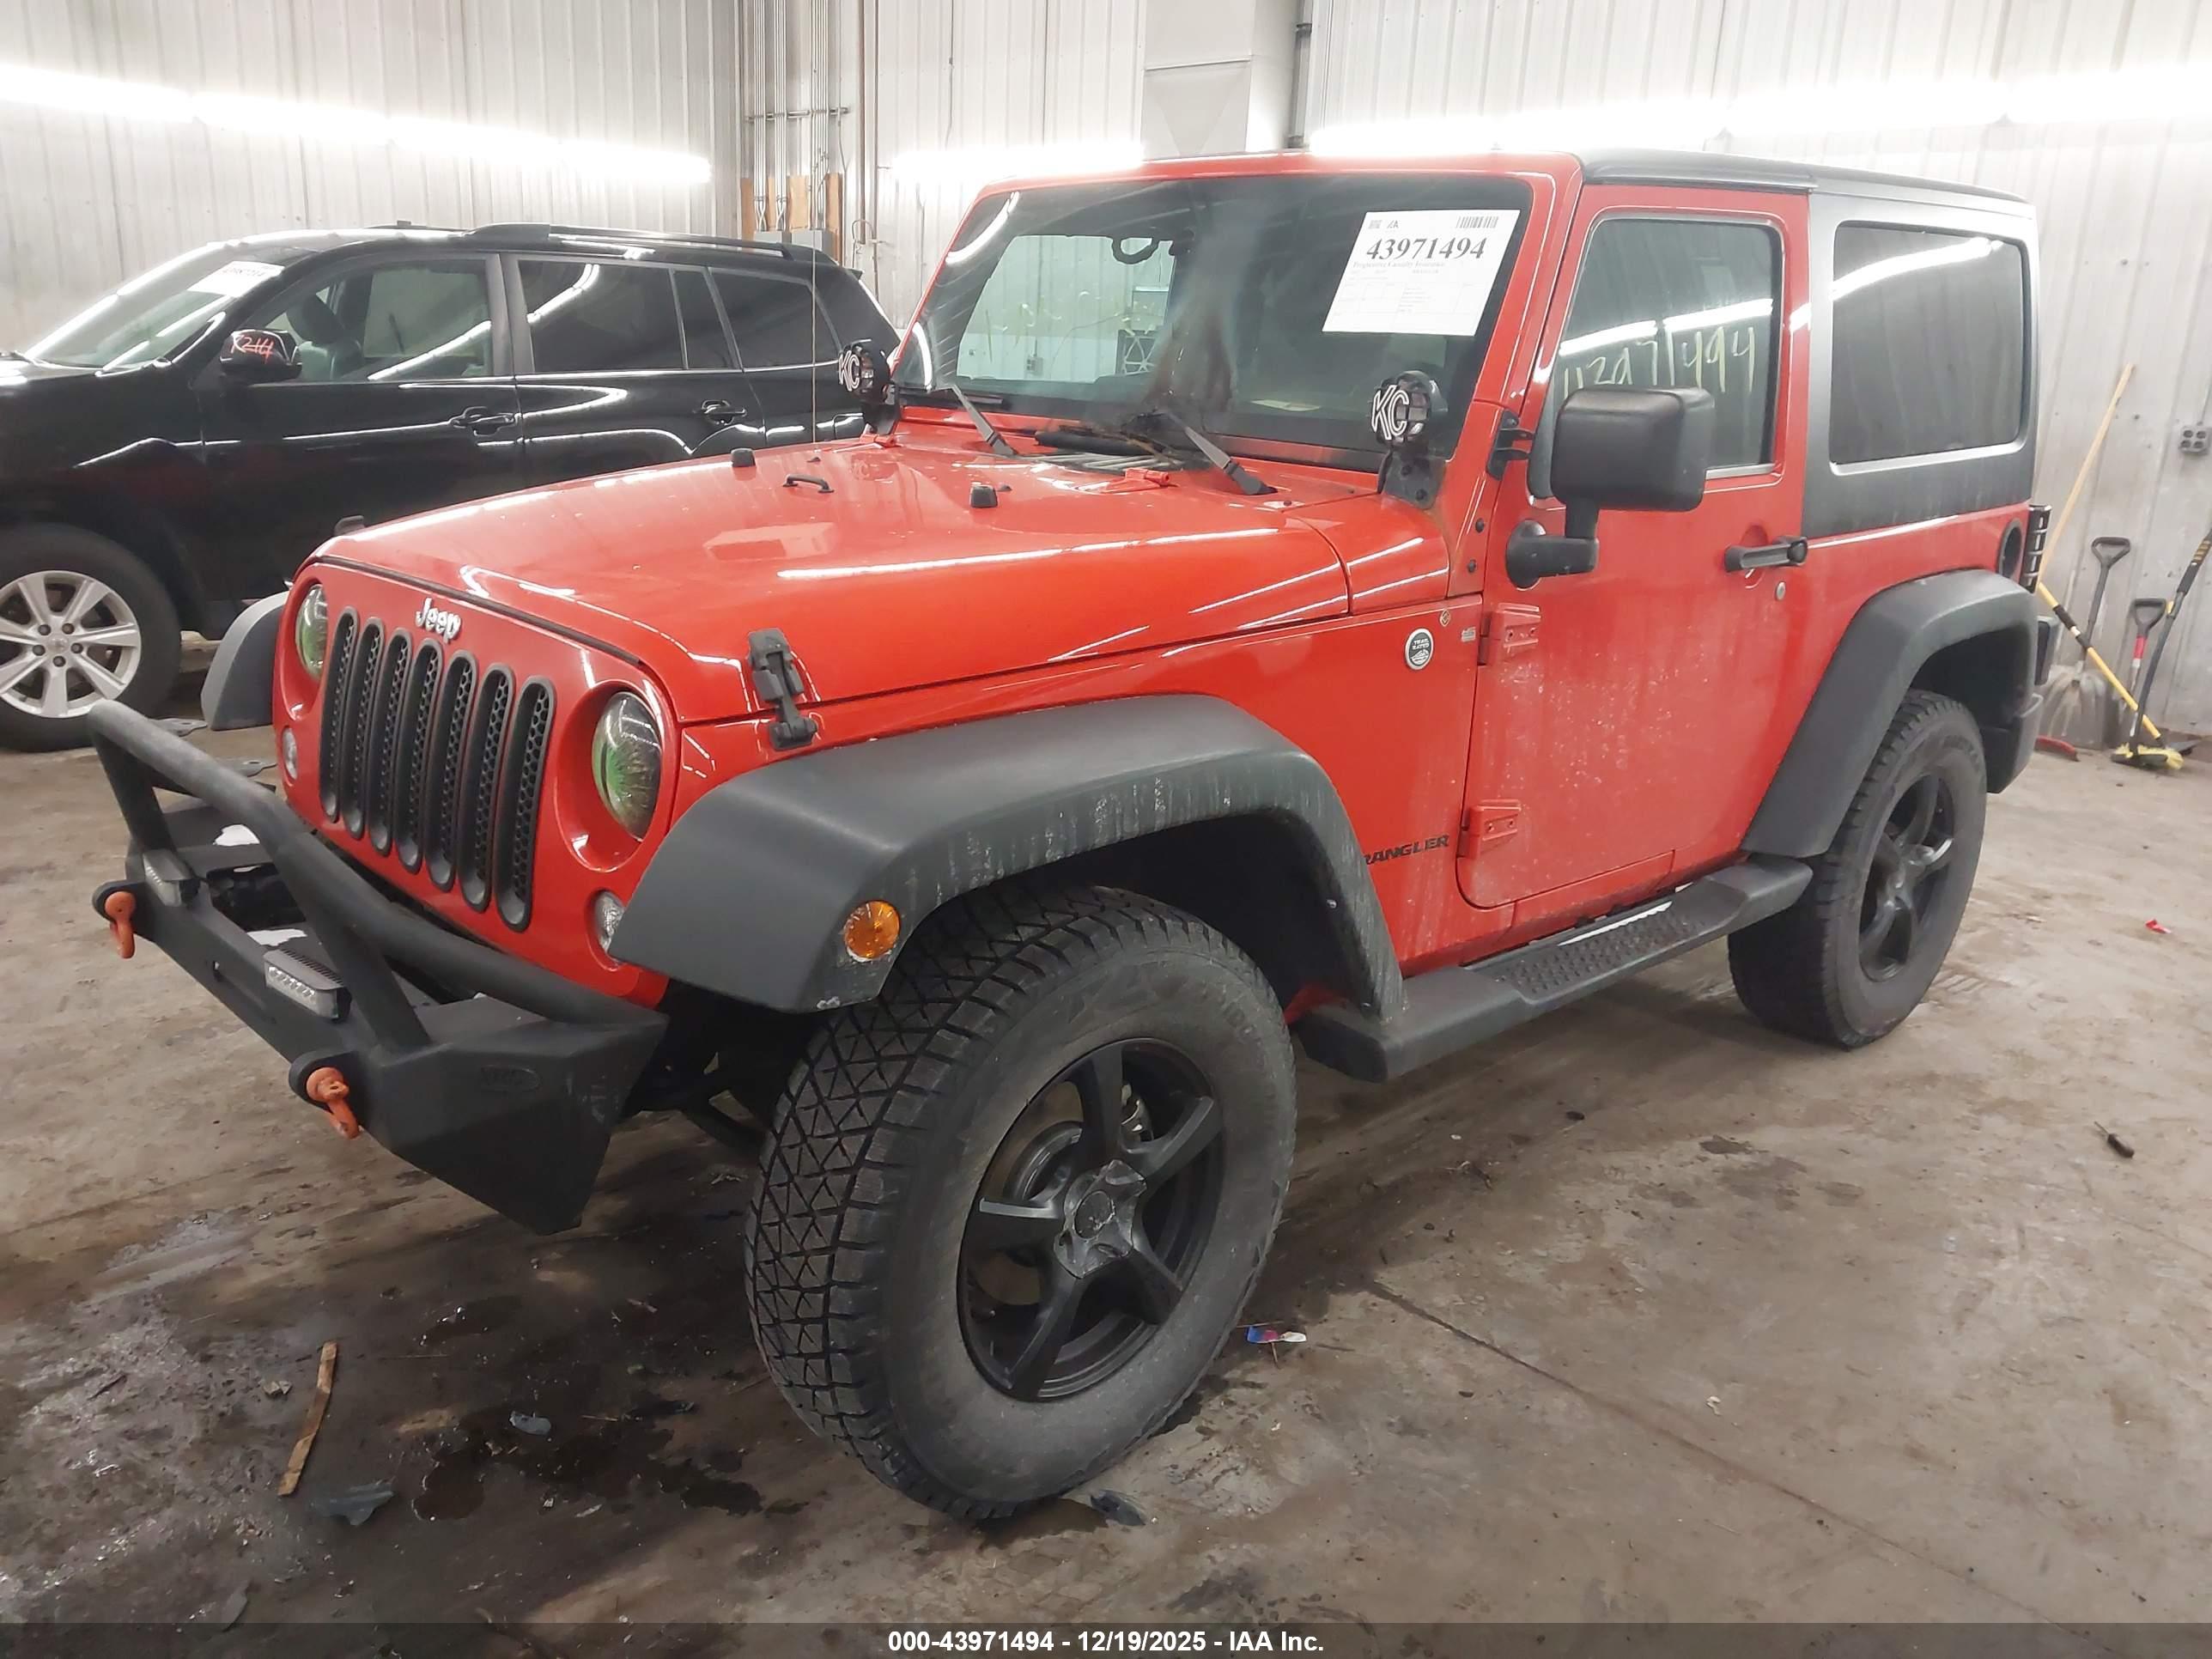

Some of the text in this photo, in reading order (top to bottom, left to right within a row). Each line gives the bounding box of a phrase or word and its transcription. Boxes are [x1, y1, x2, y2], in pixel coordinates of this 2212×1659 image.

[1366, 237, 1487, 259] 43971494
[1371, 384, 1410, 441] KC
[415, 597, 462, 644] Jeep
